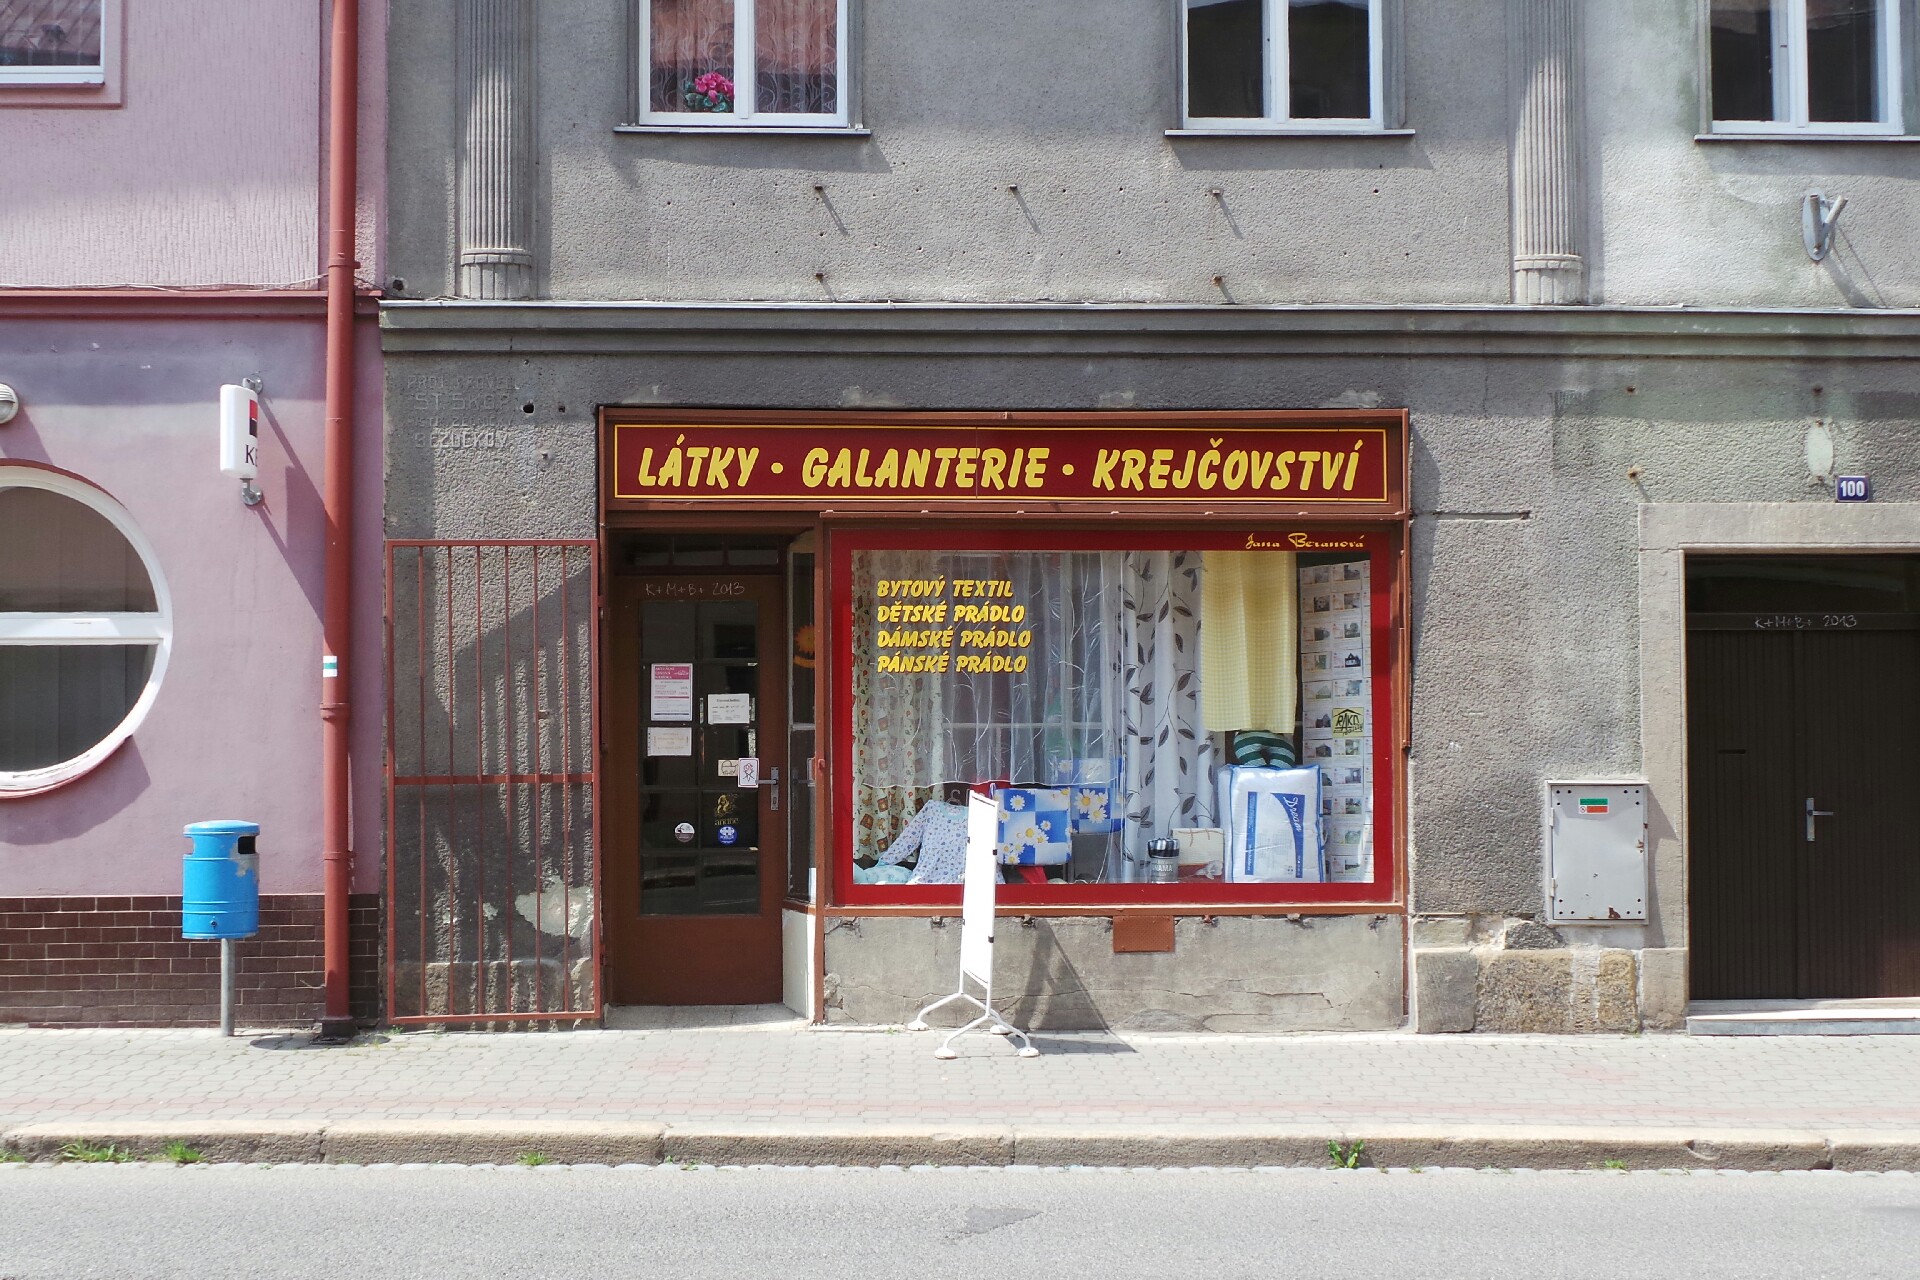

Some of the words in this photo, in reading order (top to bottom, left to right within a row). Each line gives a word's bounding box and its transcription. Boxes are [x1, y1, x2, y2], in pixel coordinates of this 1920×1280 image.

[638, 434, 760, 489] LÁTKY
[802, 447, 1050, 490] GALANTERIE
[1091, 437, 1364, 491] KREJČOVSTVÍ
[1840, 480, 1866, 497] 100
[1245, 532, 1281, 550] Jana
[1287, 532, 1365, 549] Beranová
[712, 581, 745, 596] 2013
[876, 574, 946, 598] BYTOVÝ
[953, 579, 1014, 598] TEXTIL
[877, 600, 948, 623] DĚTSKÉ
[953, 600, 1026, 623] PRÁDLO
[1822, 614, 1857, 628] 2013
[877, 625, 954, 648] DÁMSKÉ
[960, 625, 1032, 648] PRÁDLO
[877, 650, 951, 673] PÁNSKÉ
[956, 650, 1028, 673] PRÁDLO
[1283, 796, 1302, 832] Dream
